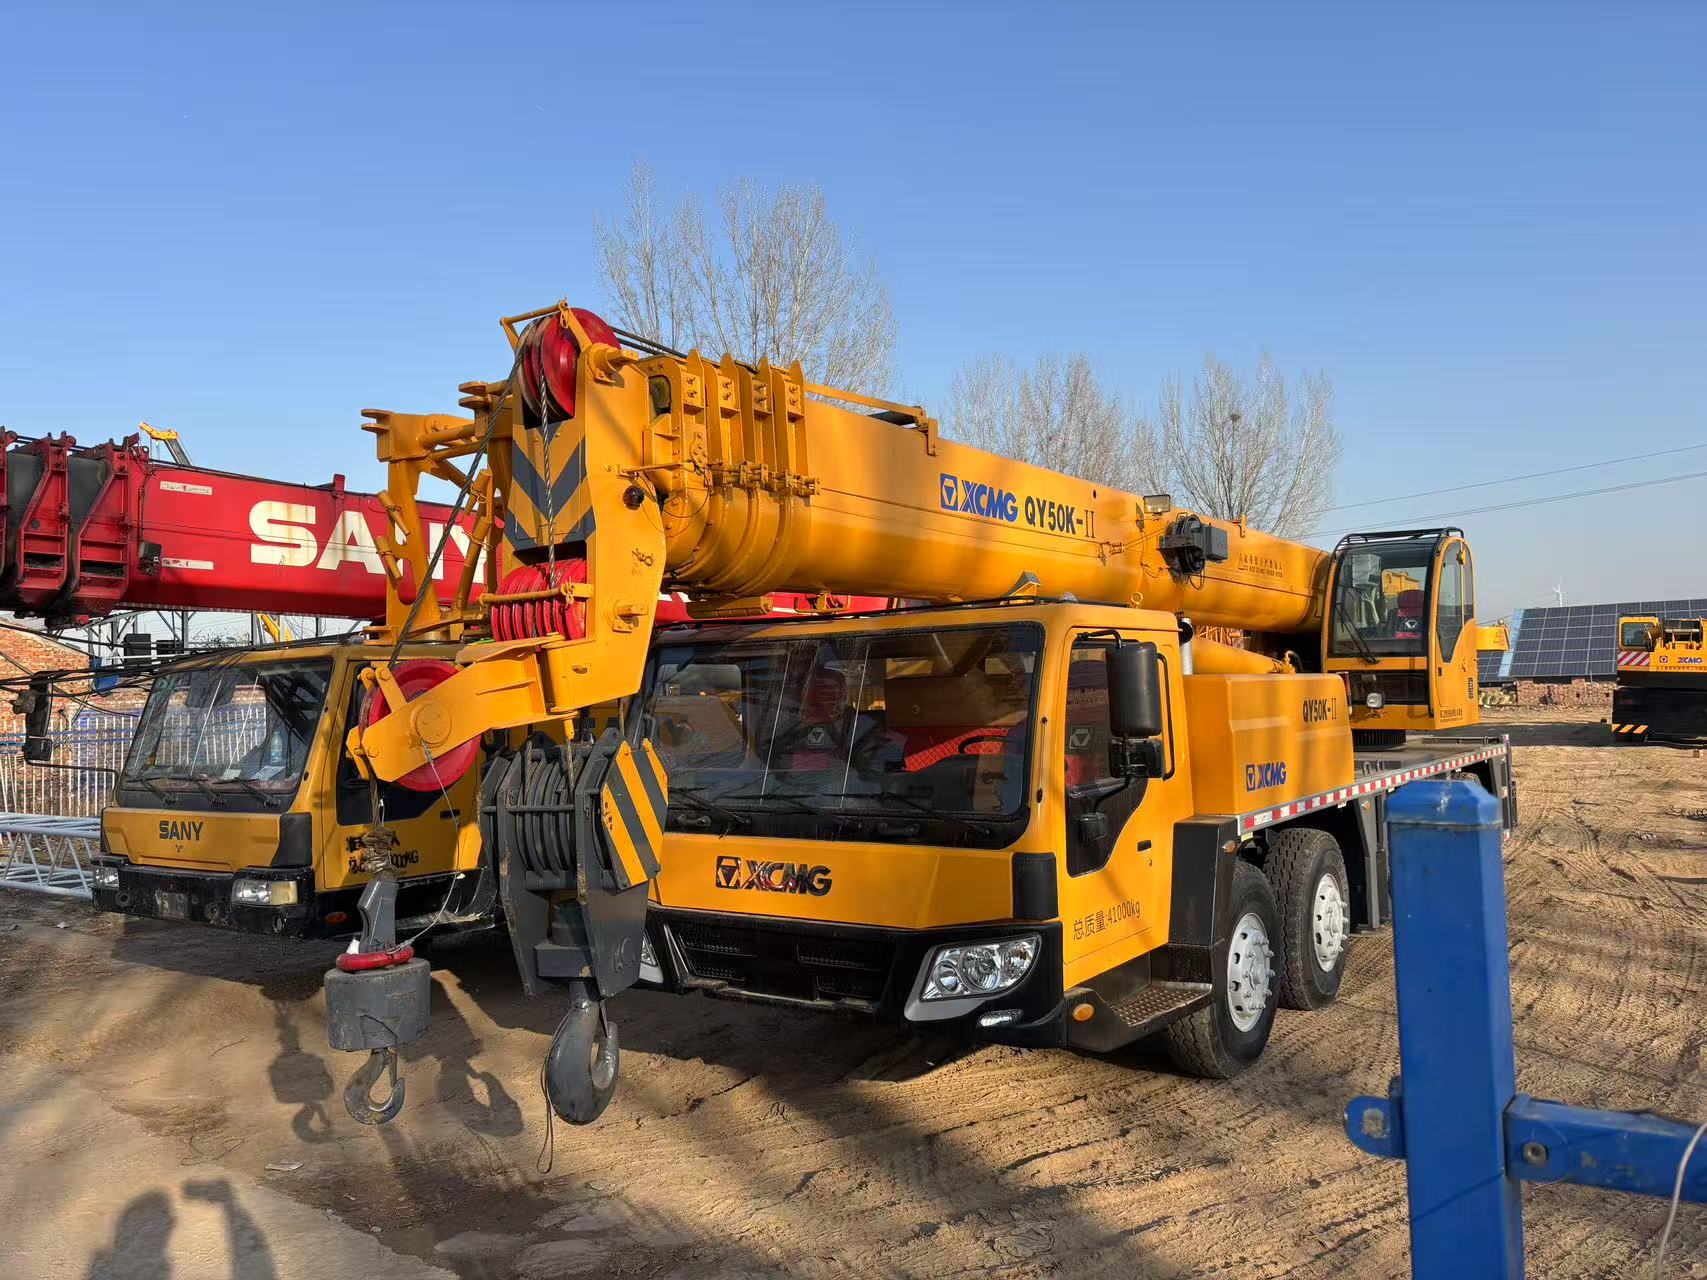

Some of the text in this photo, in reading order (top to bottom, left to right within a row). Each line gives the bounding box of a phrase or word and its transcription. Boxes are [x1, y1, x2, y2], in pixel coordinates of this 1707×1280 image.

[959, 479, 1019, 523] XCMG
[1257, 761, 1288, 790] XCMG
[159, 819, 204, 841] SANY
[741, 859, 833, 897] XCMG
